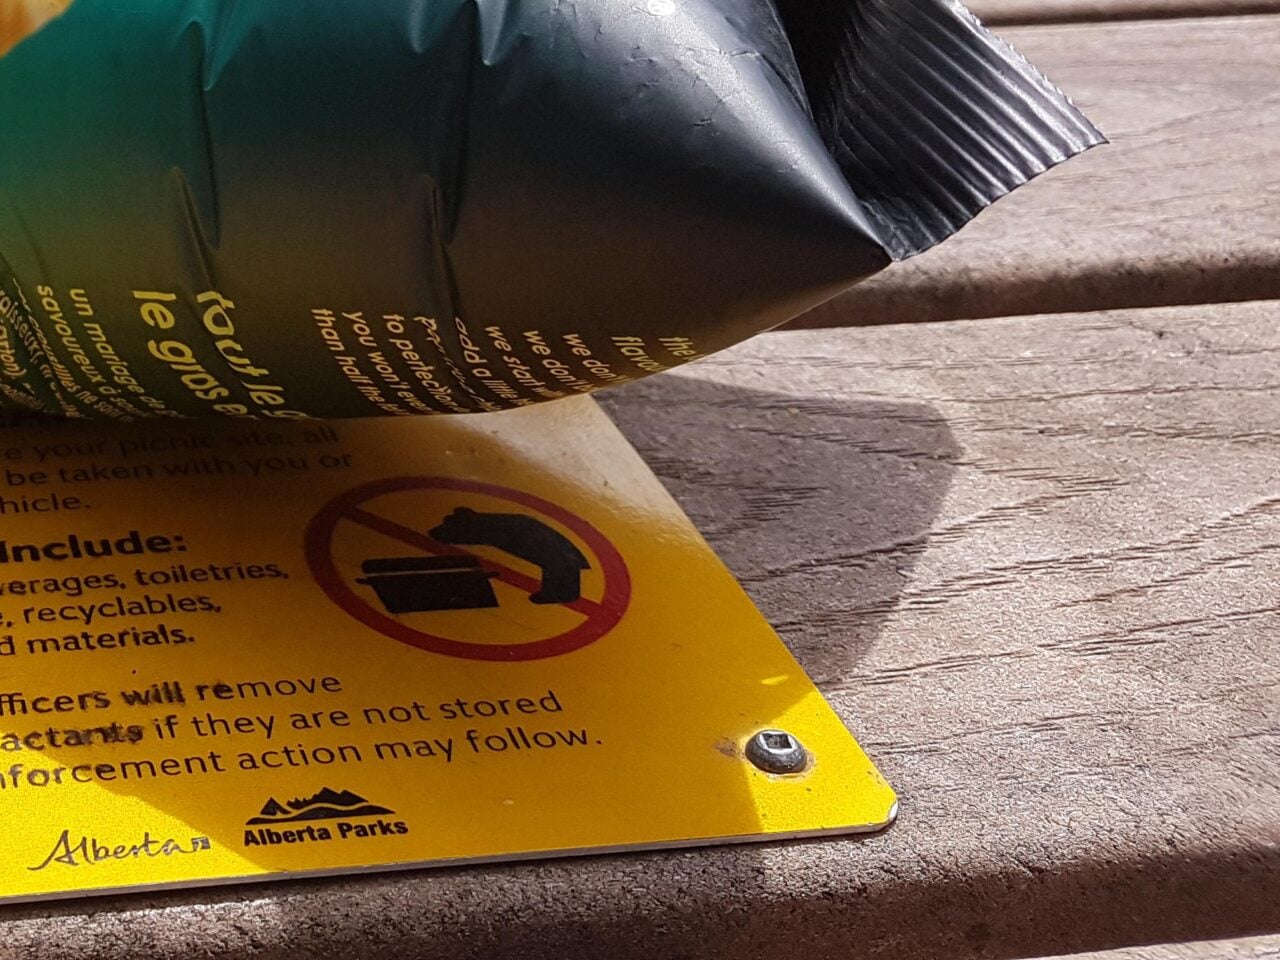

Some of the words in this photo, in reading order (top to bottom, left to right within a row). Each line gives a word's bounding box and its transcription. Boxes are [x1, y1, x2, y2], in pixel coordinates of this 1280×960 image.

[132, 290, 177, 330] le
[382, 313, 406, 334] to
[37, 284, 108, 384] savoureux
[70, 288, 94, 316] un
[83, 322, 146, 394] mariage
[196, 290, 270, 377] tout
[240, 379, 286, 405] le
[341, 312, 379, 347] you
[368, 351, 412, 389] won't
[455, 317, 489, 364] add
[523, 330, 552, 356] we
[562, 333, 592, 357] we
[657, 336, 697, 357] the
[147, 339, 230, 400] gras
[311, 308, 345, 351] than
[334, 355, 375, 384] half
[357, 386, 386, 403] the
[472, 368, 493, 377] a
[485, 326, 512, 352] we
[503, 355, 547, 387] start
[481, 379, 519, 399] little
[32, 441, 105, 463] your
[120, 434, 210, 458] picnic
[303, 425, 338, 445] all
[6, 468, 48, 486] be
[59, 461, 153, 484] taken
[162, 456, 236, 477] with
[245, 454, 308, 477] you
[318, 452, 352, 469] or
[134, 560, 289, 587] toiletries,
[23, 593, 222, 625] recyclables,
[27, 624, 195, 654] materials.
[120, 681, 186, 707] will
[194, 676, 344, 702] remove
[153, 714, 178, 740] if
[190, 711, 275, 740] they
[290, 709, 351, 730] are
[362, 701, 431, 726] not
[439, 690, 563, 721] stored
[238, 742, 362, 770] action
[373, 737, 454, 763] may
[466, 726, 602, 754] follow.
[27, 829, 192, 871] Alberta
[243, 825, 333, 847] Alberta
[336, 819, 409, 839] Parks
